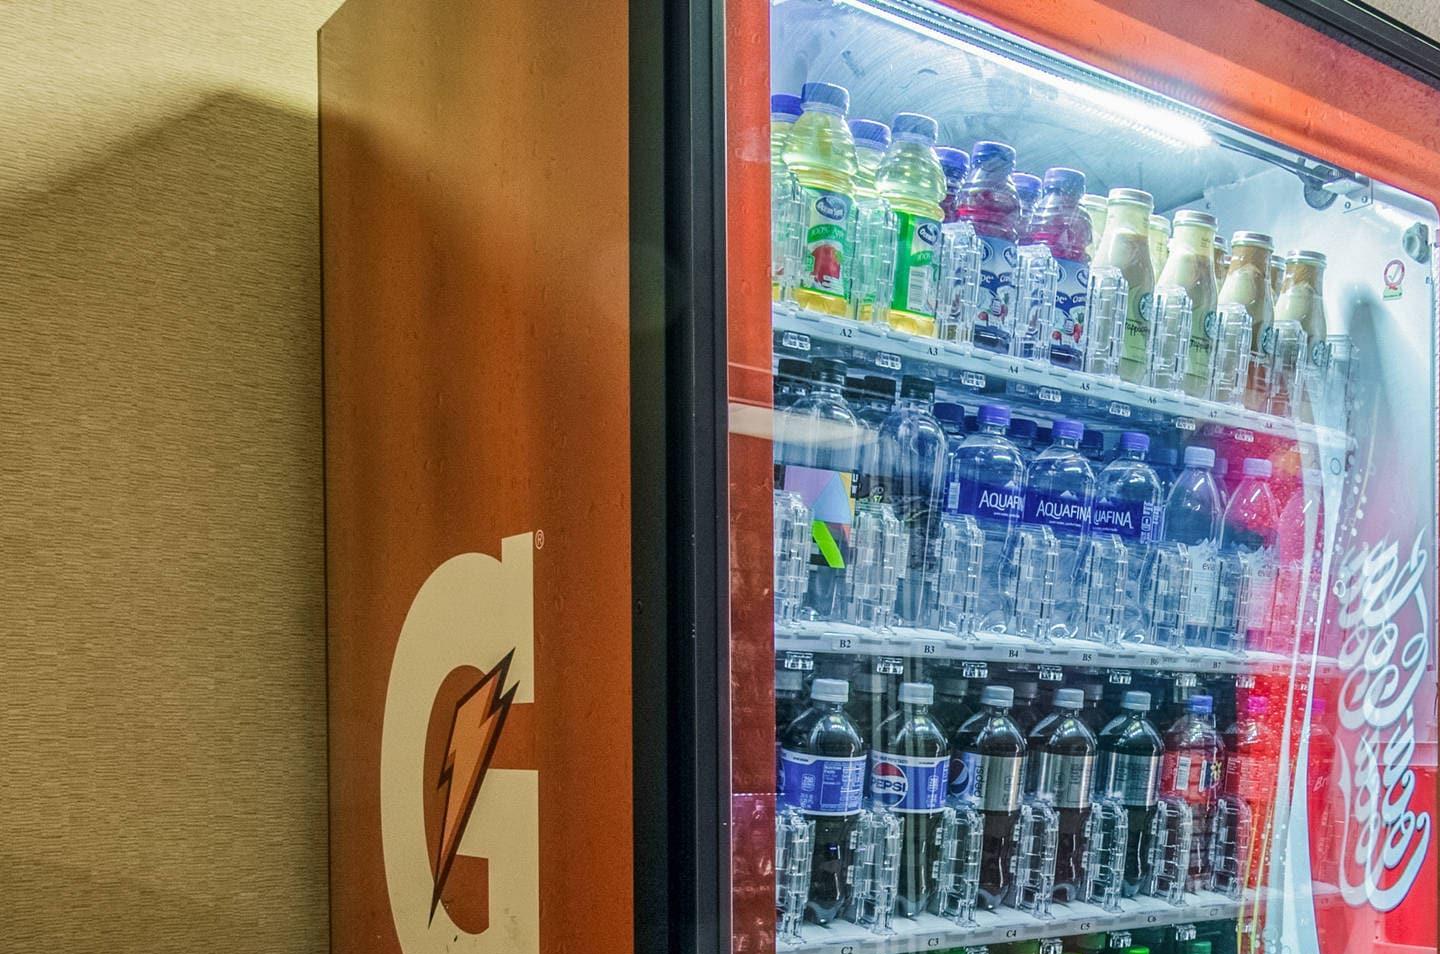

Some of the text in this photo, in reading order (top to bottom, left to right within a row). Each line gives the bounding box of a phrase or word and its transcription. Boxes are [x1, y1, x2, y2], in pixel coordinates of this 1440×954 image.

[839, 329, 853, 339] A2
[928, 347, 939, 356] A3
[1008, 365, 1019, 374] A4
[1080, 382, 1090, 391] A5
[1036, 500, 1092, 525] AQUAFINA
[839, 639, 852, 649] B2
[924, 645, 935, 653] B3
[1008, 649, 1019, 658] B4
[1082, 653, 1092, 662] B5
[1080, 922, 1091, 931] C5
[1006, 929, 1017, 938] C4
[927, 937, 939, 946] C3
[840, 946, 853, 954] C2
